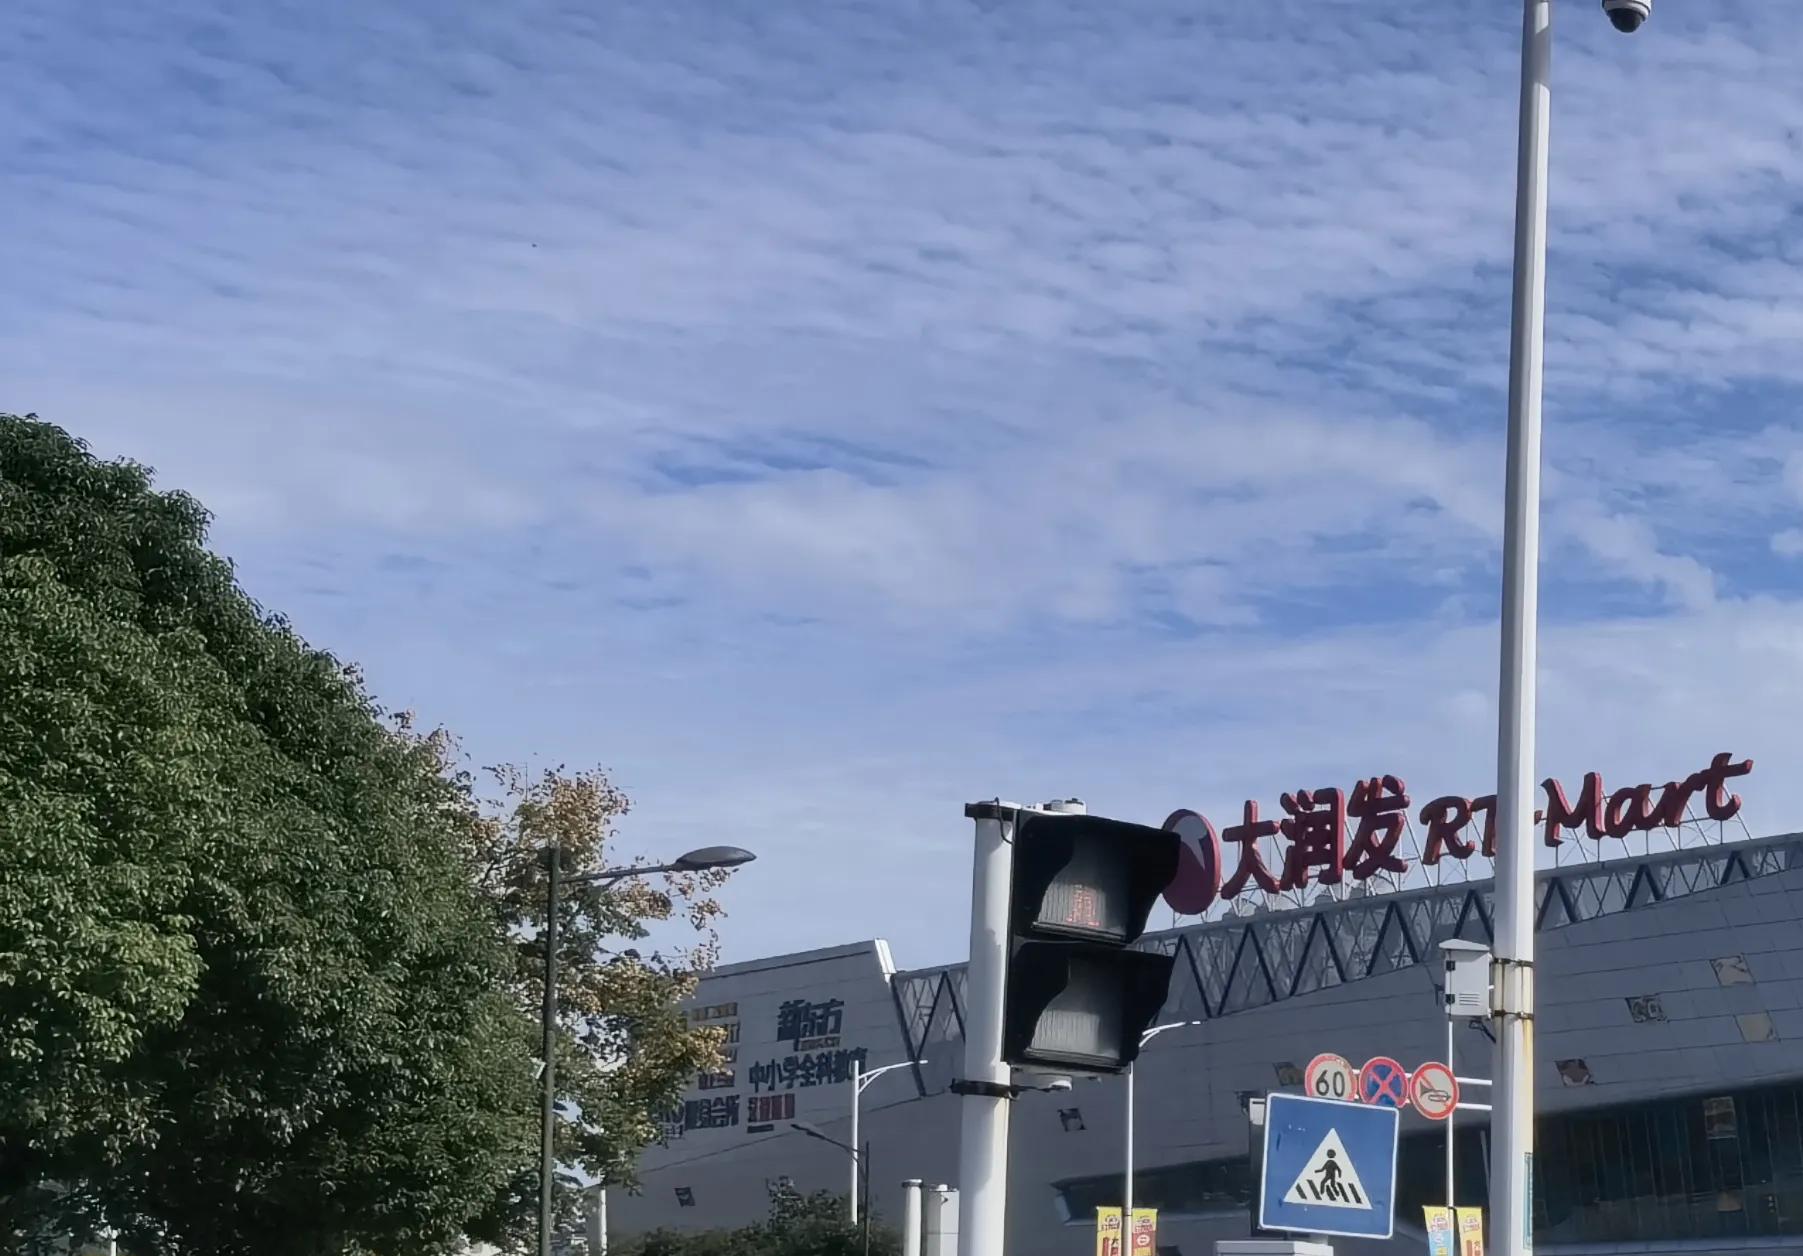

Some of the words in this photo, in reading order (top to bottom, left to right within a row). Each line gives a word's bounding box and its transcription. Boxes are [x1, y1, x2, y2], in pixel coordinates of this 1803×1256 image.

[1221, 774, 1410, 900] 大润发
[1316, 1070, 1345, 1098] 60
